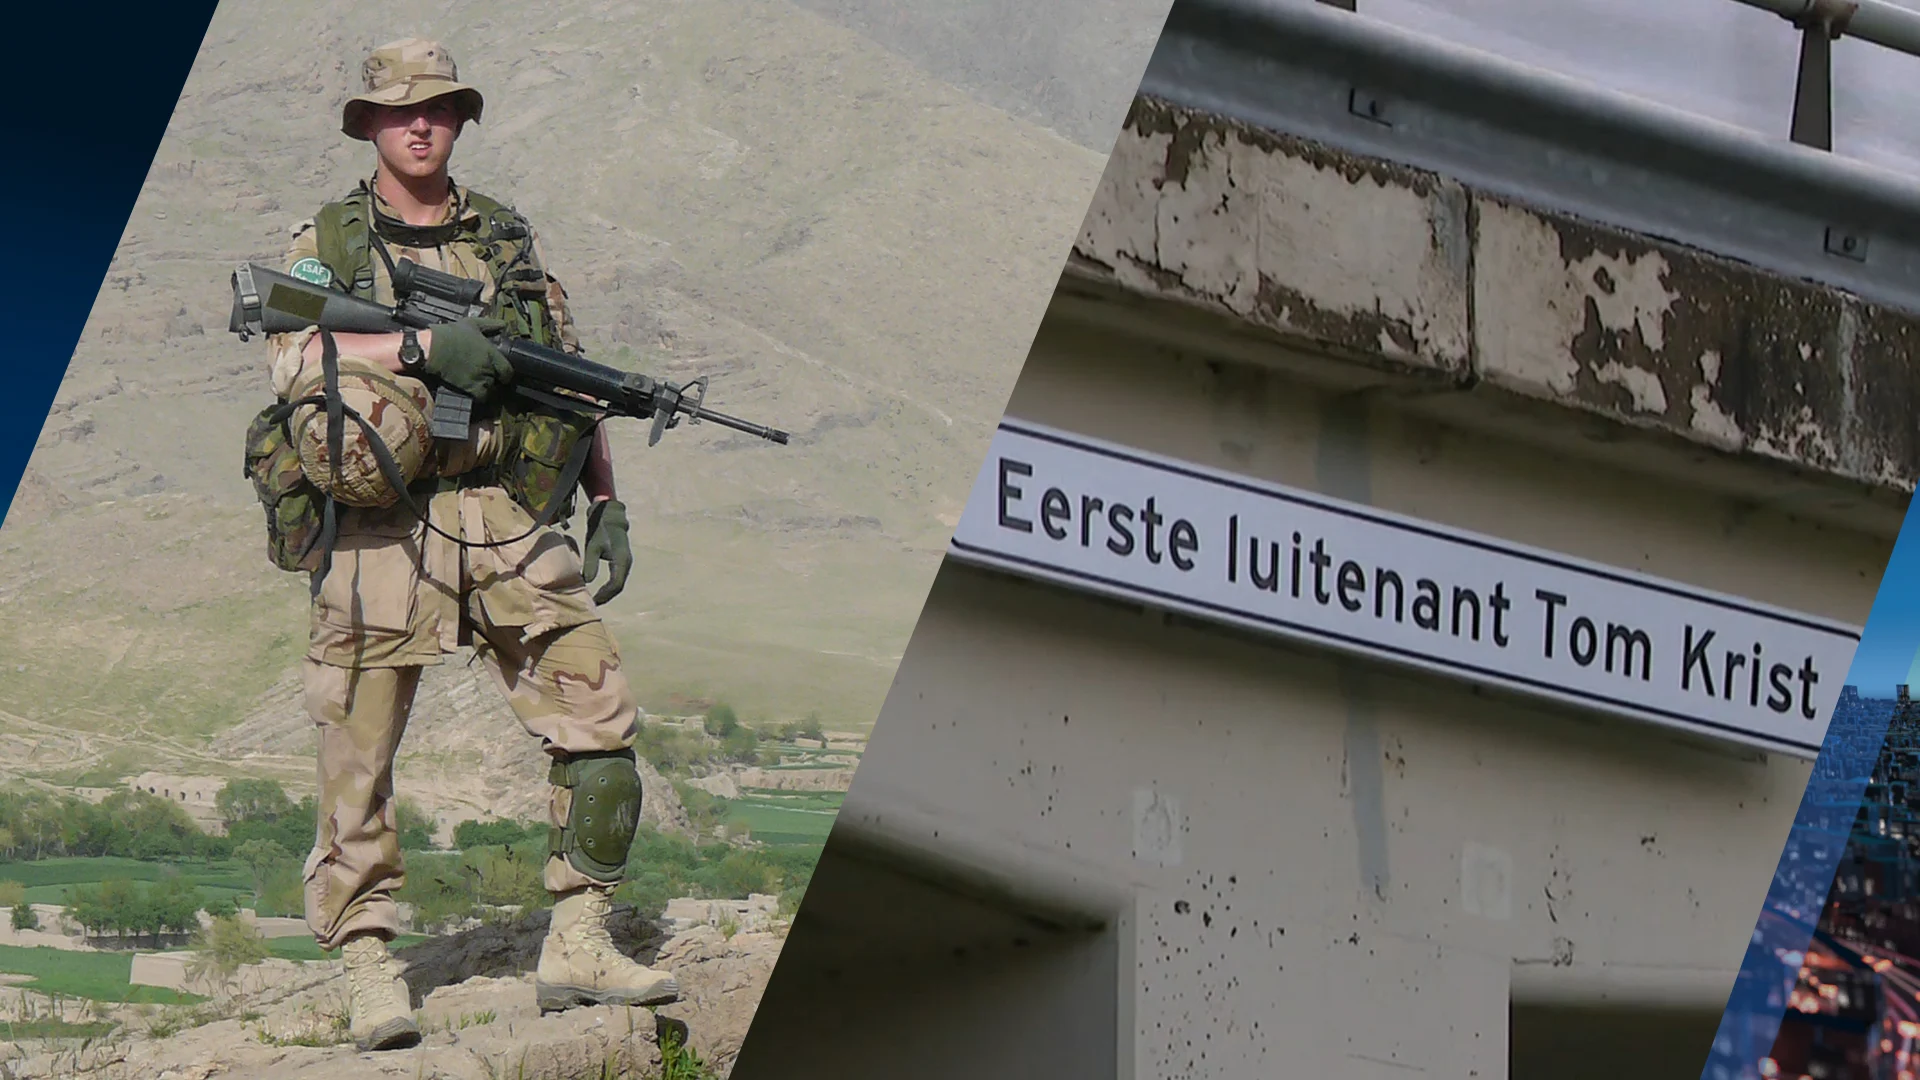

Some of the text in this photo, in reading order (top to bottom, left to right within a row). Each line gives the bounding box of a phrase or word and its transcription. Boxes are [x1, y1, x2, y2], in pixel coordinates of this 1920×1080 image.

[302, 263, 326, 276] ISAF
[997, 456, 1819, 720] Eerste luitenant Tom Krist
